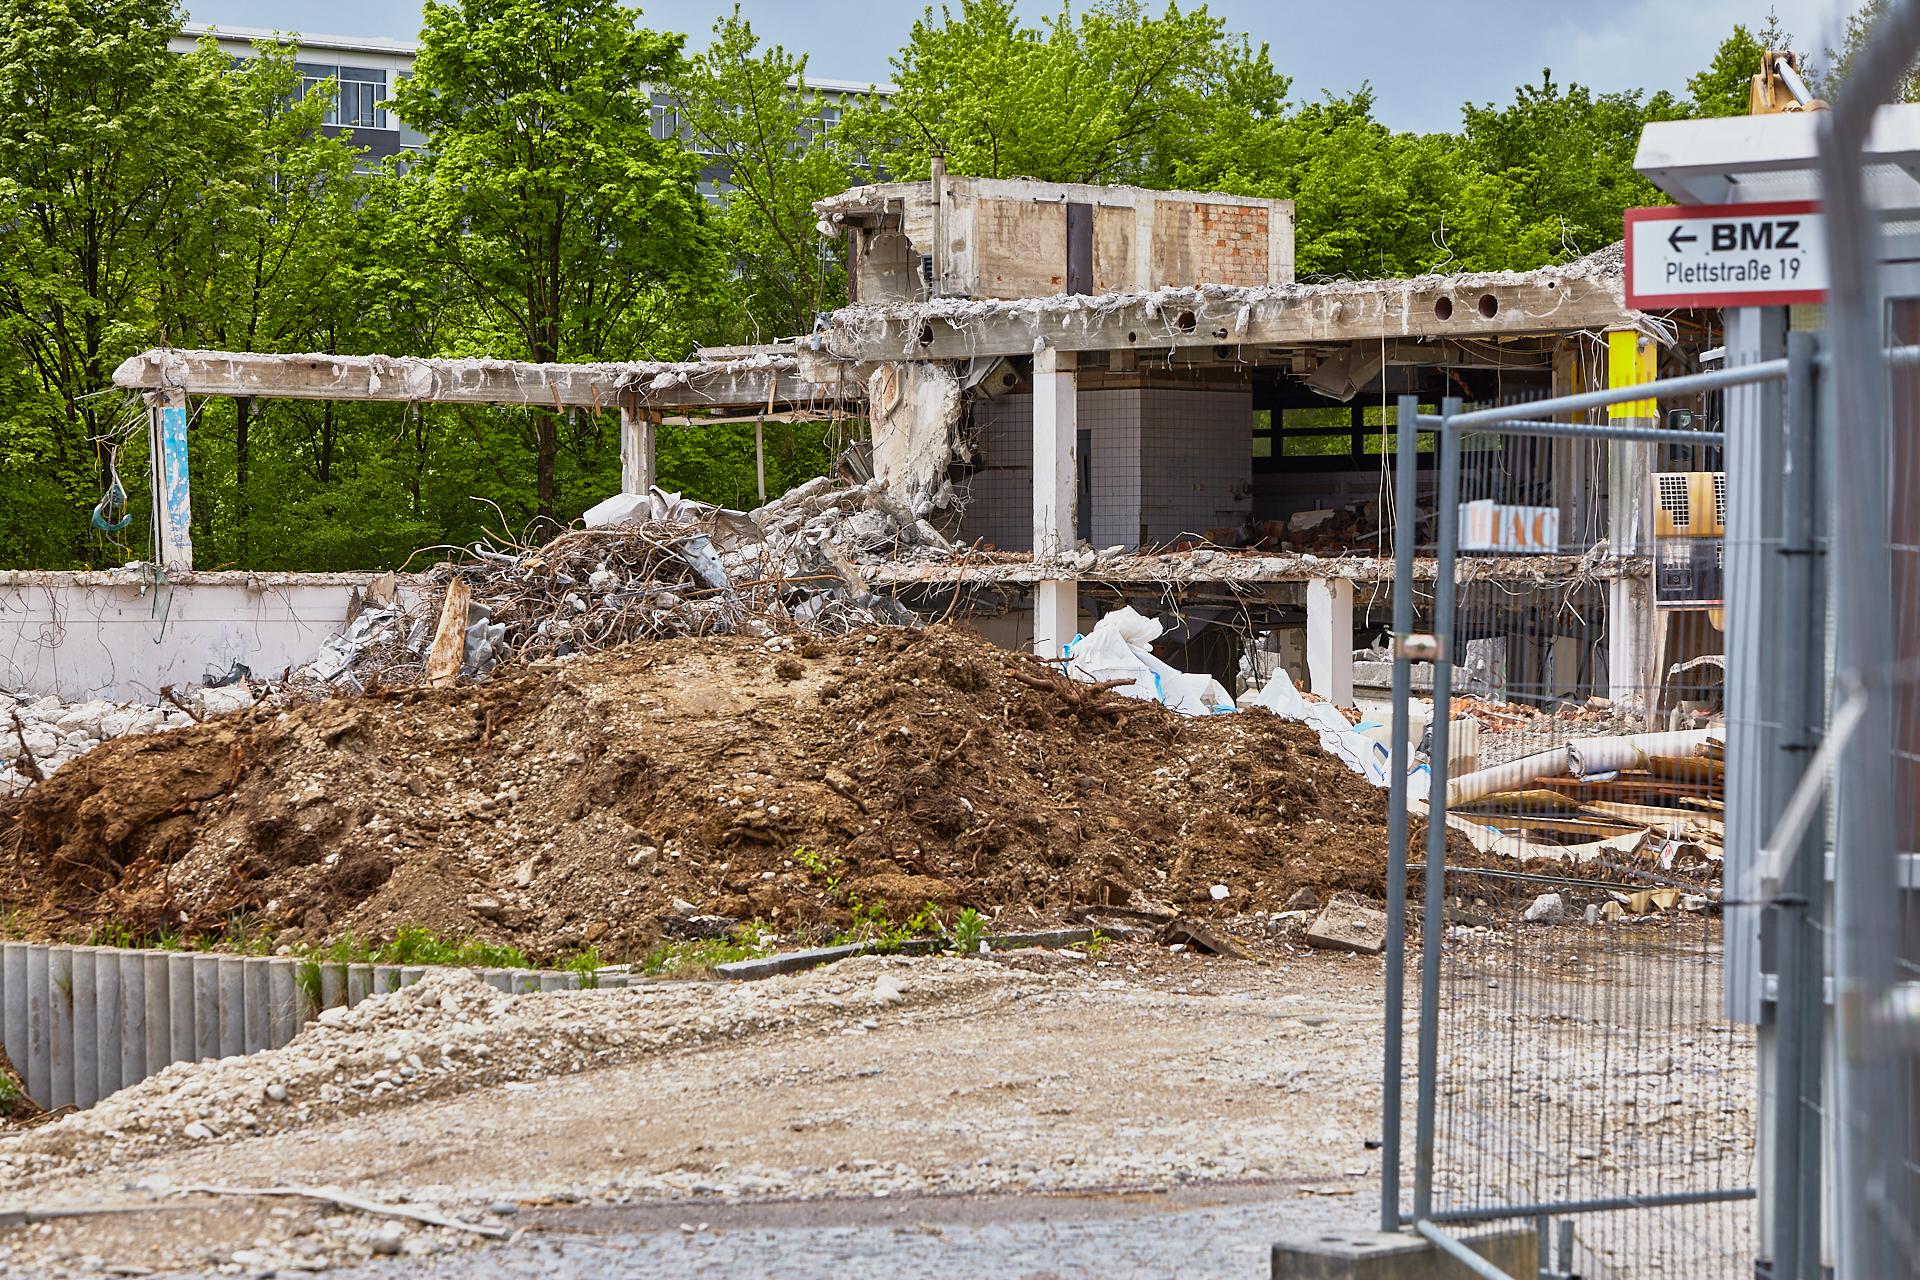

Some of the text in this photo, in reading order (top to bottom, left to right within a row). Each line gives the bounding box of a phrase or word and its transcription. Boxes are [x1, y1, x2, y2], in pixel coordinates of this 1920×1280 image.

[1712, 221, 1800, 251] BMZ
[1666, 257, 1801, 283] Plettstraße 19
